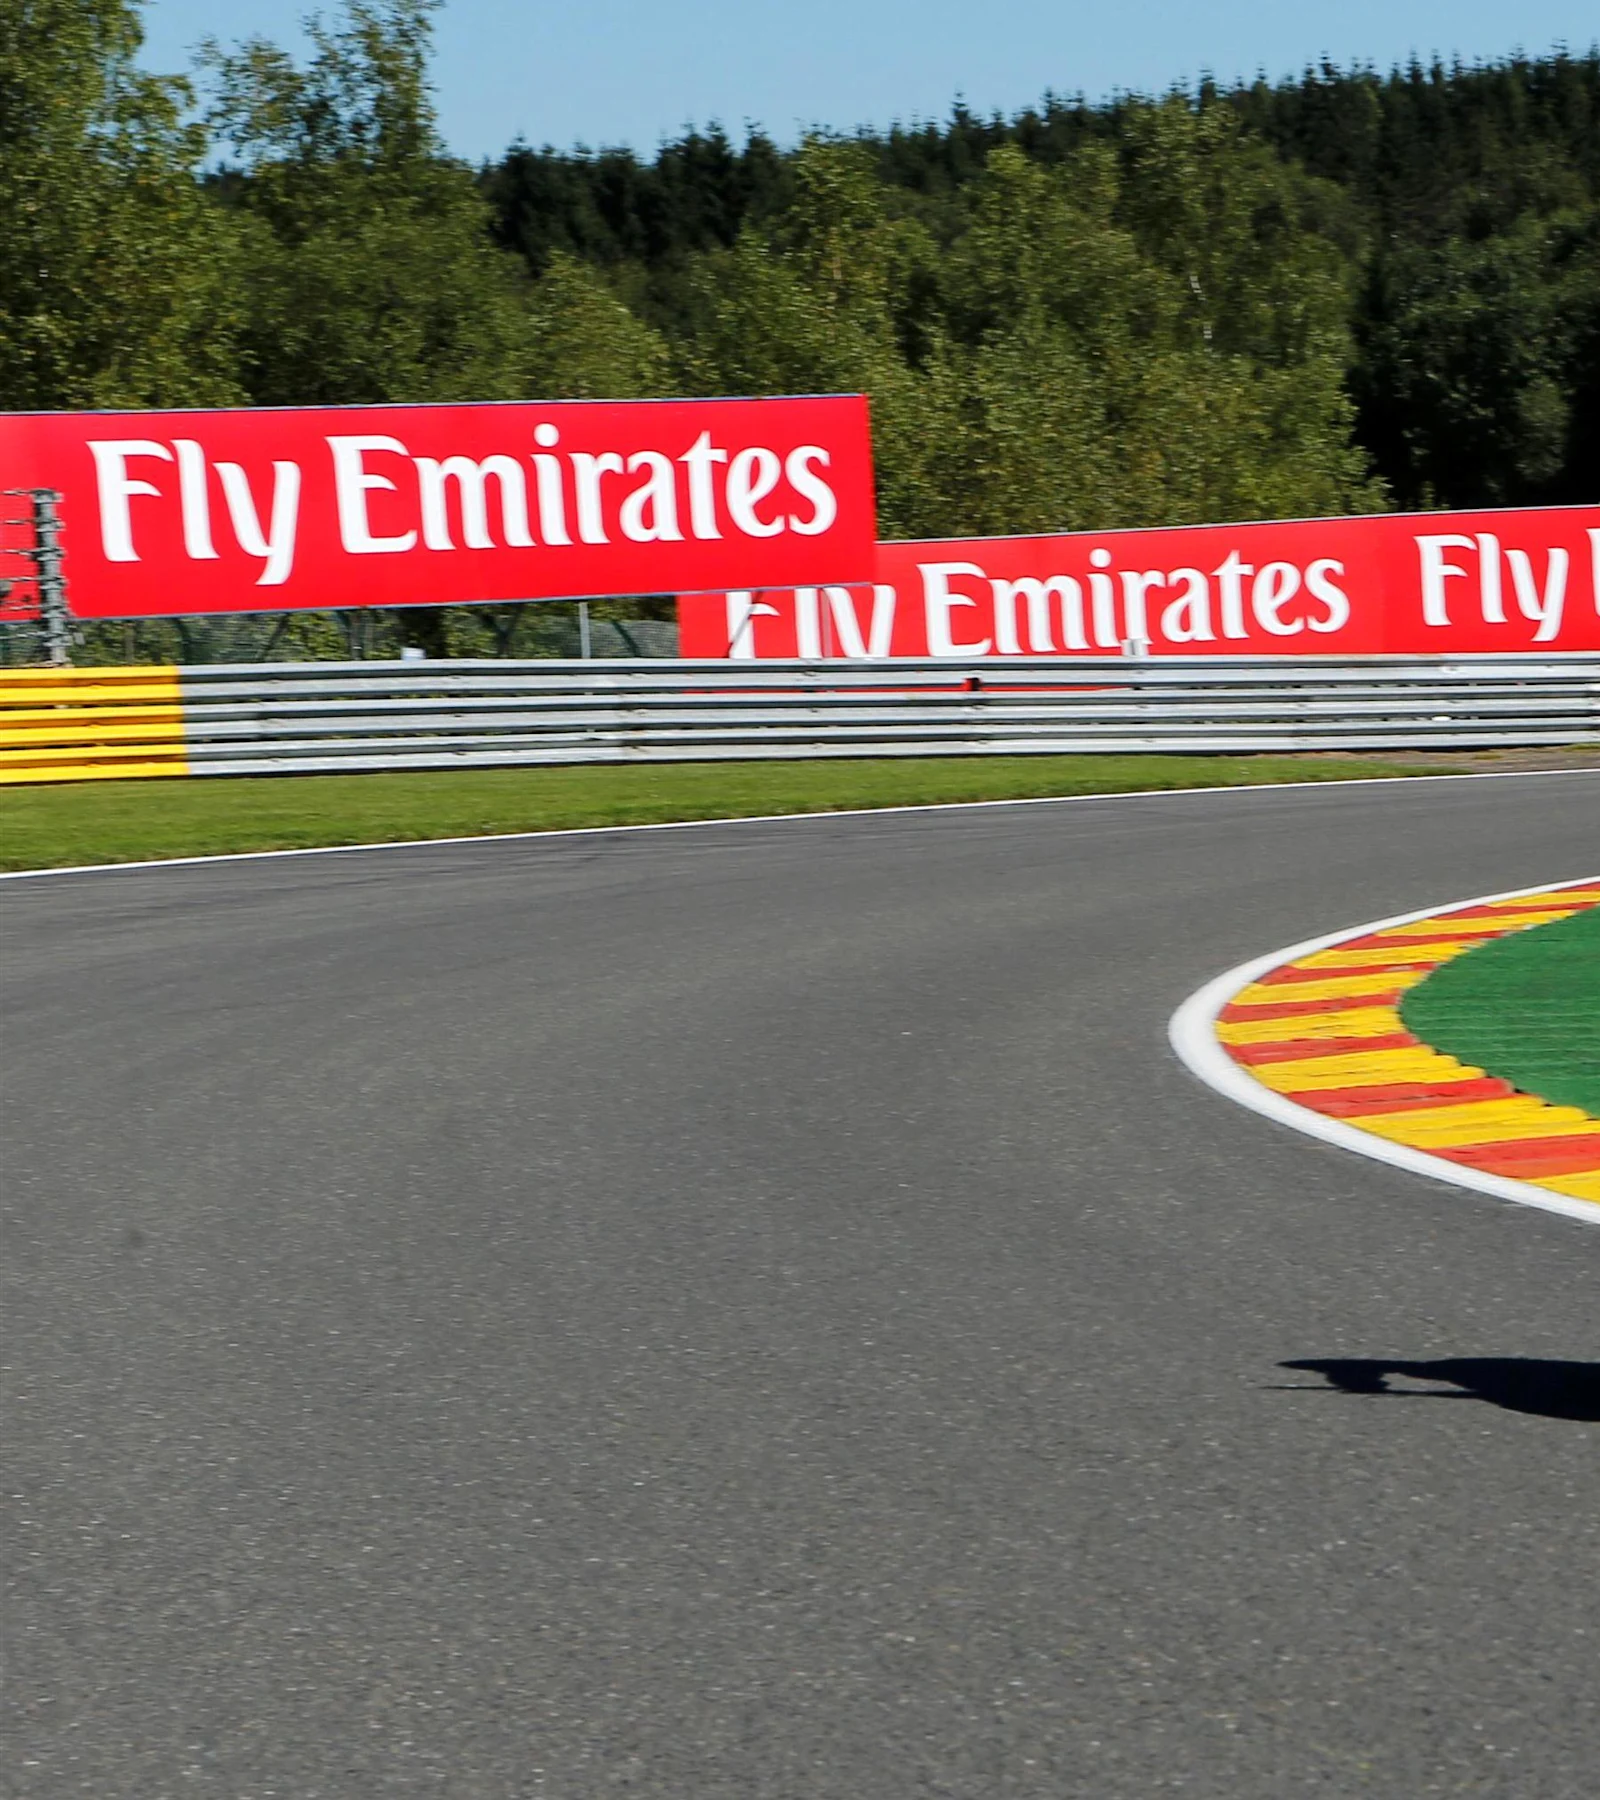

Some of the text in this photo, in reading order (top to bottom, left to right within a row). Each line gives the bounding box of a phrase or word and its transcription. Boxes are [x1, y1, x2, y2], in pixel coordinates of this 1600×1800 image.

[86, 423, 838, 586] Fly Emirates
[916, 548, 1351, 657] Emirates
[1415, 532, 1569, 642] Fly
